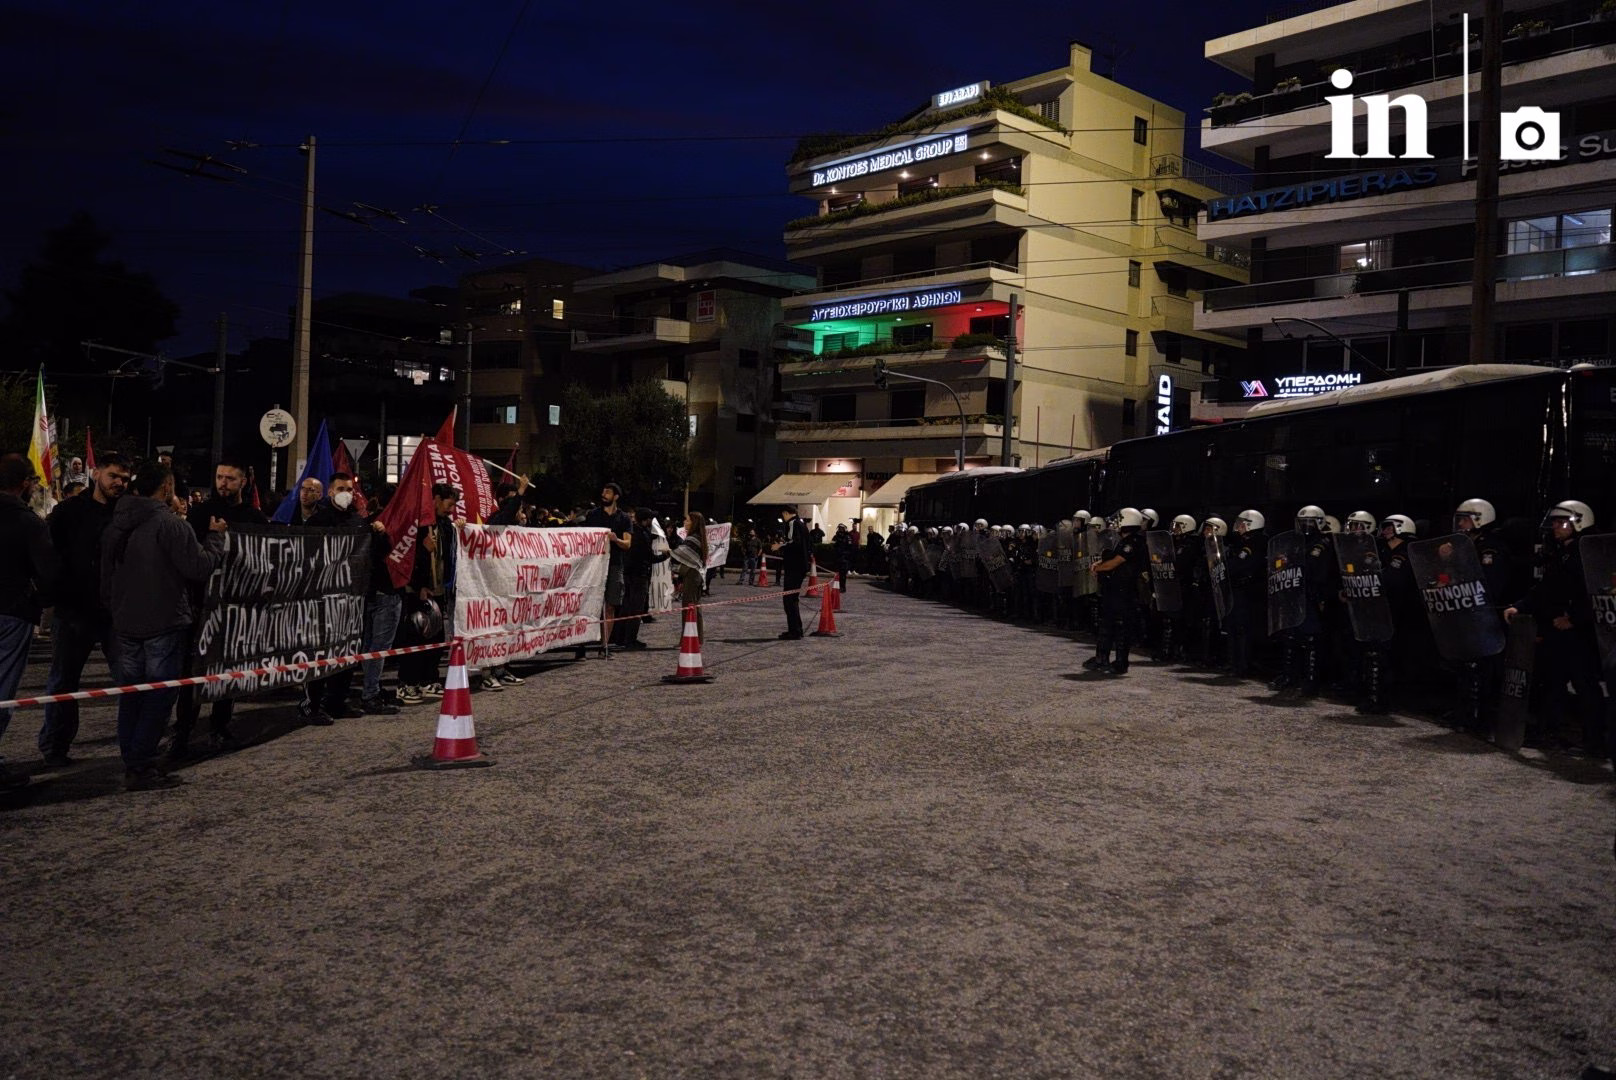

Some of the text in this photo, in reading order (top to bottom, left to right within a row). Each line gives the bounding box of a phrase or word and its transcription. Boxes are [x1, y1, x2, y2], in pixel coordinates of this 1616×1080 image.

[812, 171, 826, 187] Dr.
[826, 160, 869, 183] KONTOES
[870, 150, 914, 172] MEDICAL
[915, 139, 953, 161] GROUP
[1211, 166, 1439, 219] HATZIPIERAS
[811, 290, 961, 321] ΑΓΓΕΙΟΧΕΙΡΟΥΡΓΙΚΗ ΑΘΗΝΩΝ
[1274, 373, 1361, 388] ΥΠΕΡΔΟΜΗ
[466, 599, 491, 630] ΝΙΚΗ
[1427, 594, 1487, 613] POLICE
